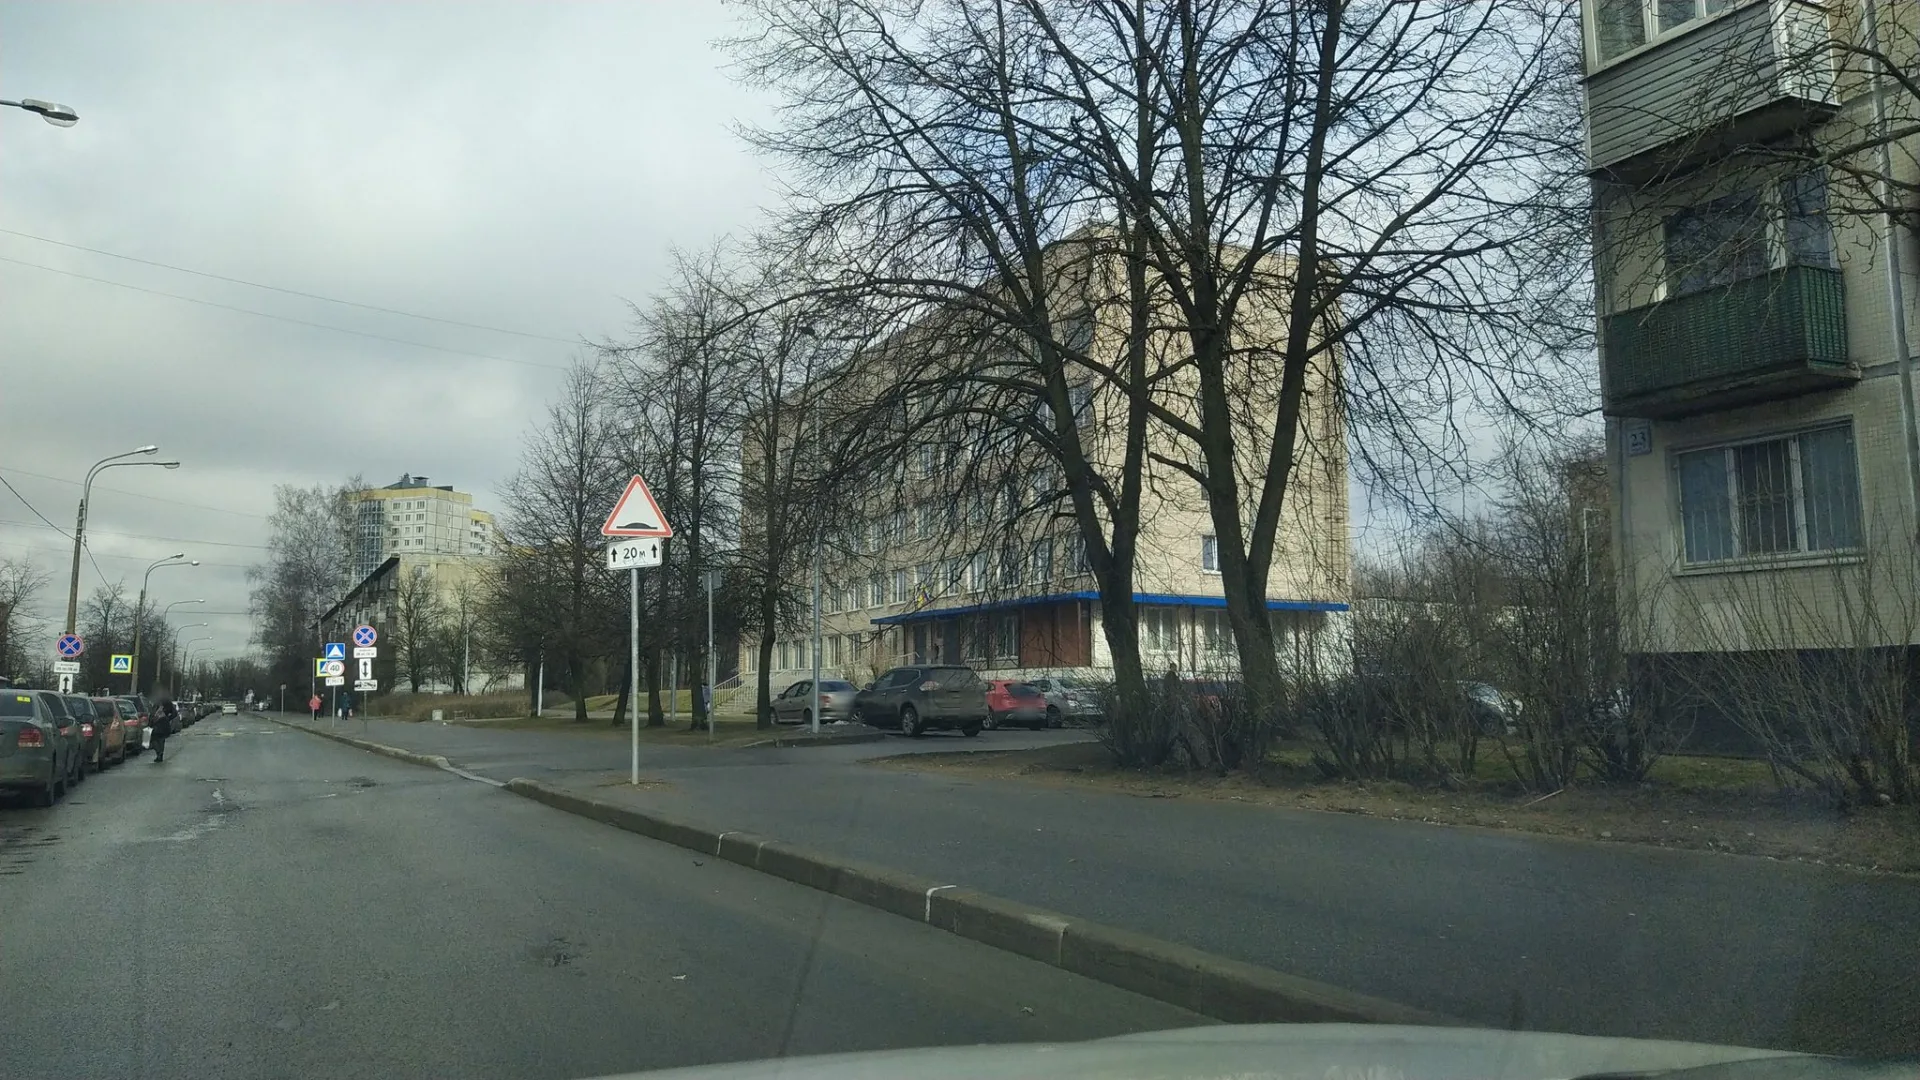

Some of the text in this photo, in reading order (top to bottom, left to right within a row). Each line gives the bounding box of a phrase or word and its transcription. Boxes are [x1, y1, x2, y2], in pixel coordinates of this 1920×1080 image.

[1631, 431, 1646, 447] 23
[623, 547, 637, 559] 20
[330, 664, 340, 672] 40
